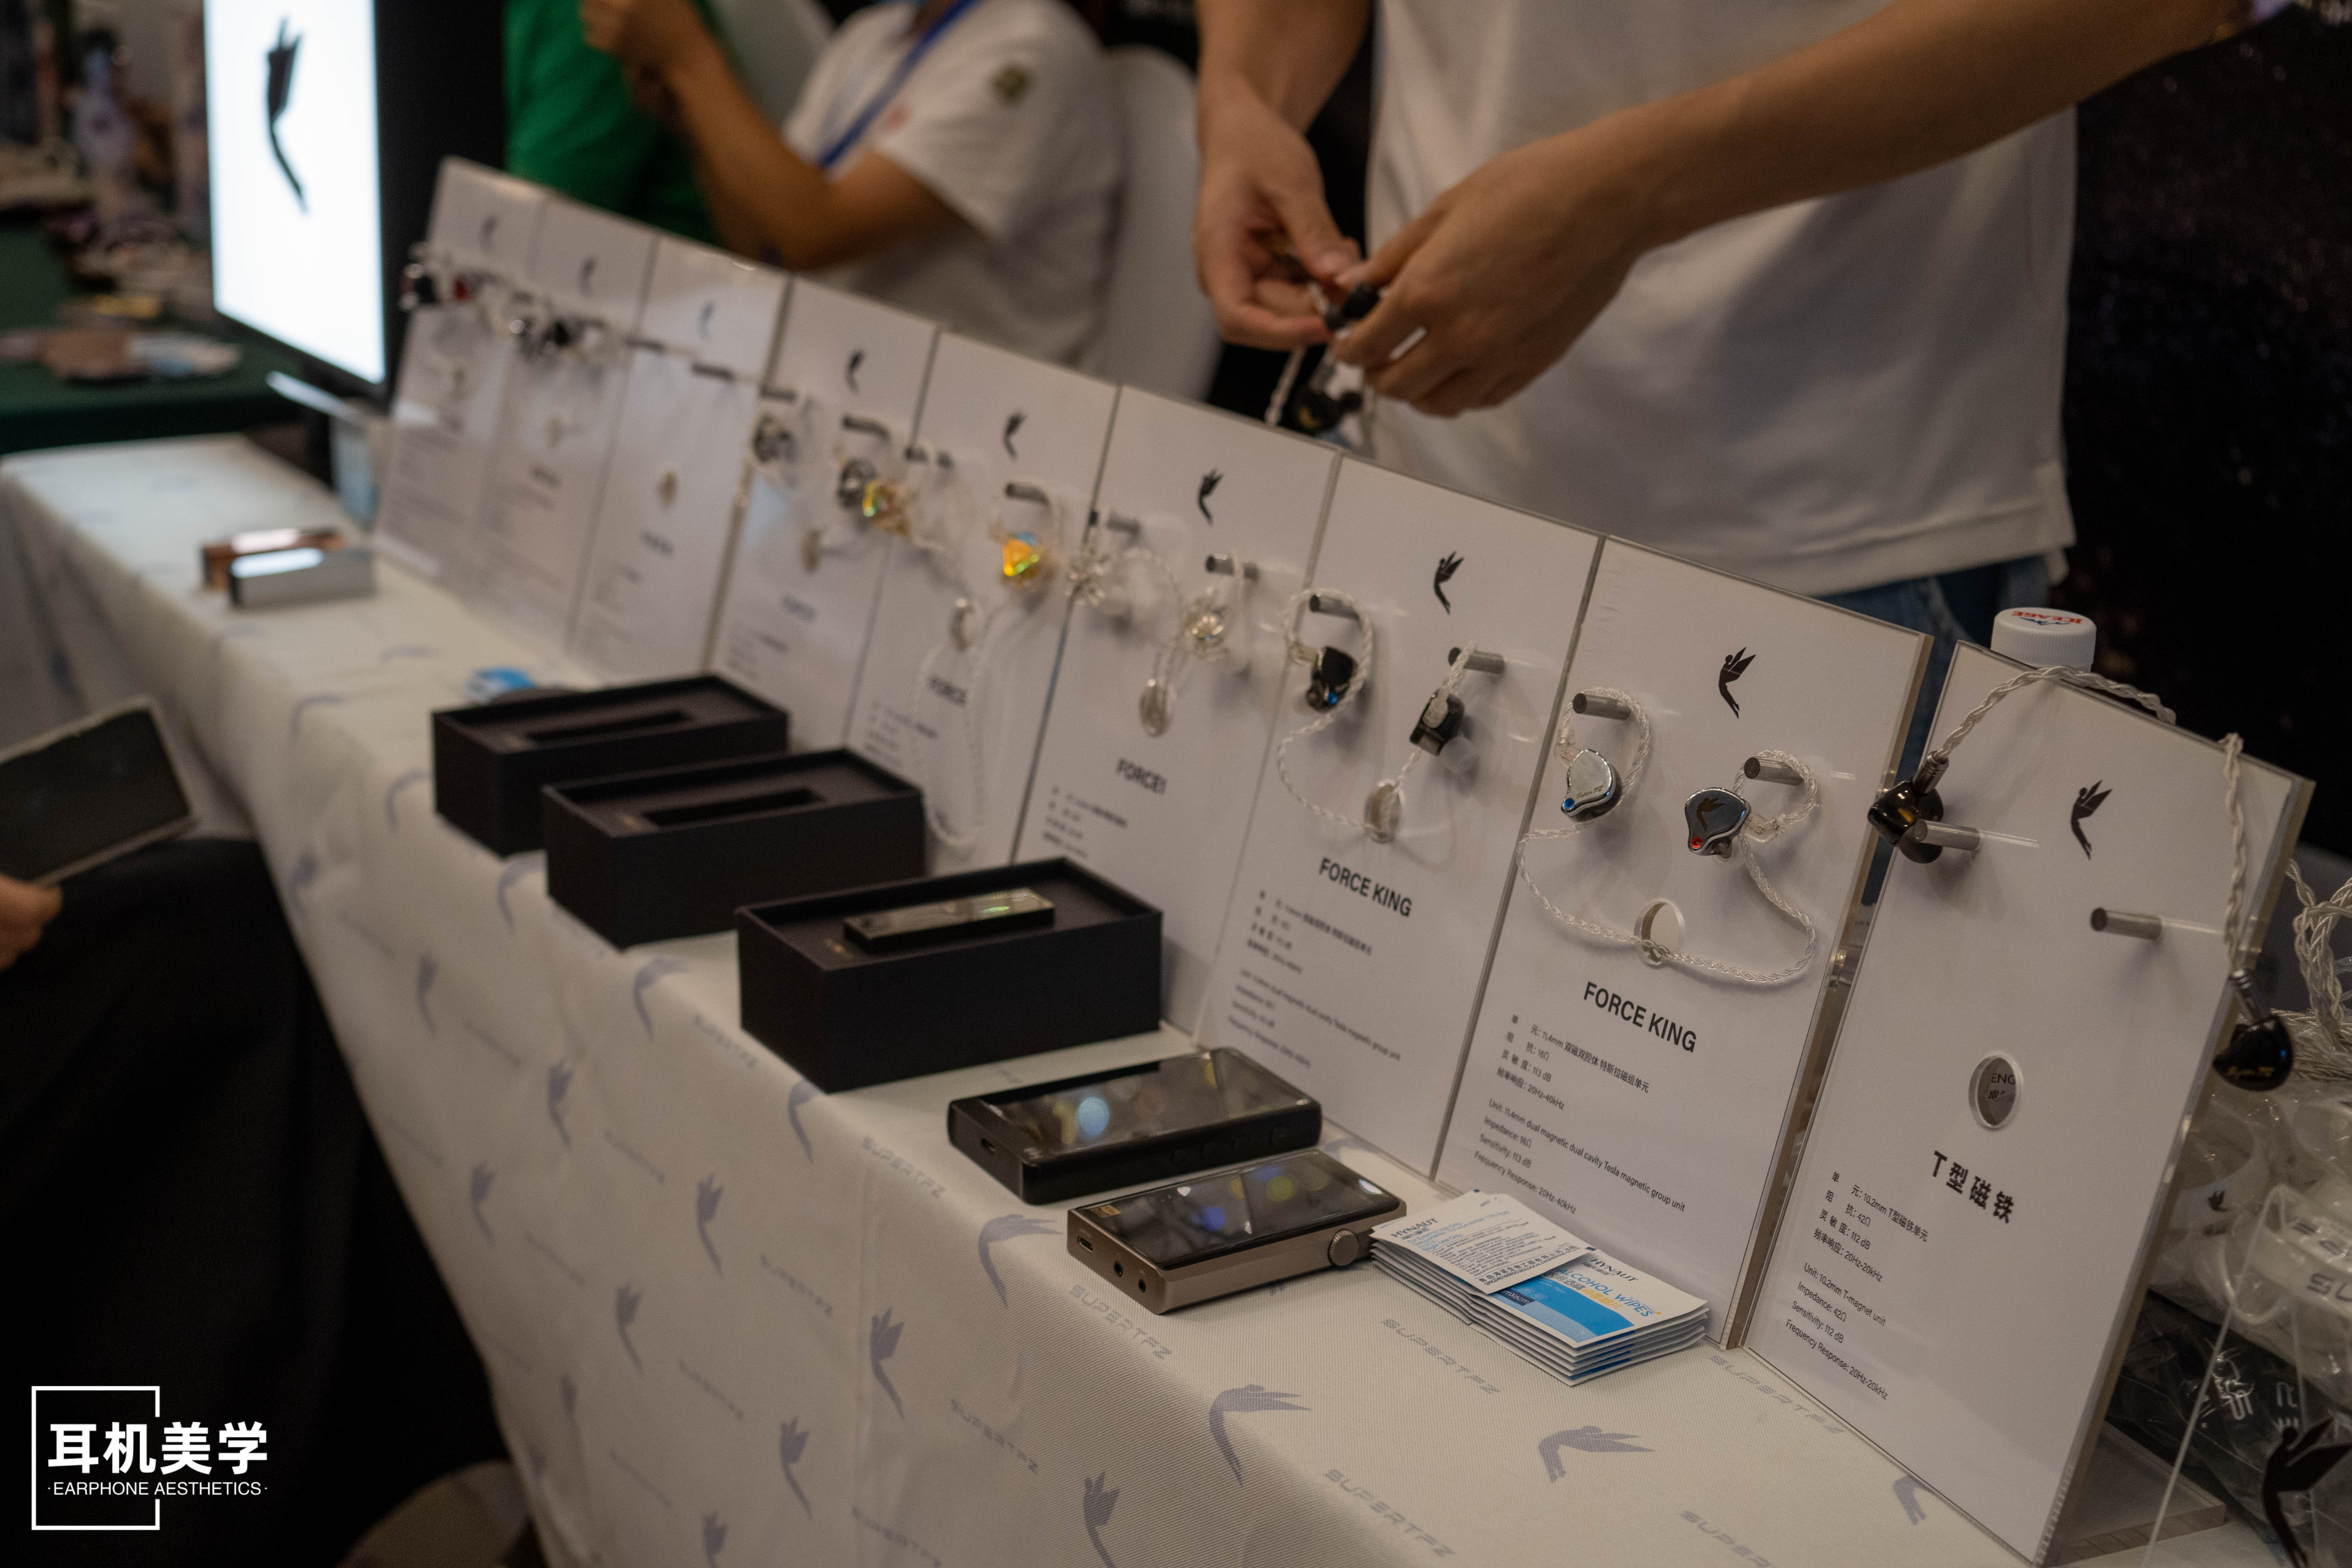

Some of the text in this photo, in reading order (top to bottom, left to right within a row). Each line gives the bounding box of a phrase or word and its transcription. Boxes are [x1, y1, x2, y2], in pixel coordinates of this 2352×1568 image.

[2011, 610, 2082, 624] ICEAGE
[1319, 857, 1412, 918] FORCE KING
[1584, 982, 1697, 1053] FORCE KING
[1541, 1071, 1552, 1083] dB
[1526, 1118, 1541, 1134] dual
[1539, 1125, 1569, 1151] magnetic
[1569, 1141, 1584, 1157] dual
[1583, 1149, 1604, 1169] cavity
[1603, 1160, 1620, 1177] Tesla
[1620, 1169, 1651, 1196] magnetic
[1650, 1187, 1671, 1207] group
[1671, 1197, 1686, 1213] unit
[1390, 1218, 1438, 1238] HYNAUT
[1850, 1230, 1861, 1244] 112
[1860, 1237, 1871, 1251] dB
[1862, 1192, 1888, 1216] 10.2mm
[1887, 1207, 1929, 1243] T型磁铁单元
[1590, 1258, 1639, 1281] HYNAUT
[1844, 1250, 1883, 1283] 20Hz-20kHz
[1558, 1269, 1614, 1296] ALCOHOL
[1615, 1294, 1653, 1317] WIPES
[1797, 1281, 1847, 1323] Impedance: 42Ω
[1803, 1262, 1887, 1327] Unit: 10.2mm T-magnet unit
[1069, 1284, 1172, 1360] SUPERTFZ
[1791, 1299, 1844, 1344] Sensitivity: 112 dB
[1381, 1317, 1501, 1395] SUPERTFZ
[1784, 1318, 1889, 1401] Frequency Response: 20Hz-20kHz
[1710, 1354, 1845, 1435] SUPERTFZ
[1323, 1467, 1456, 1559] SUPERTFZ
